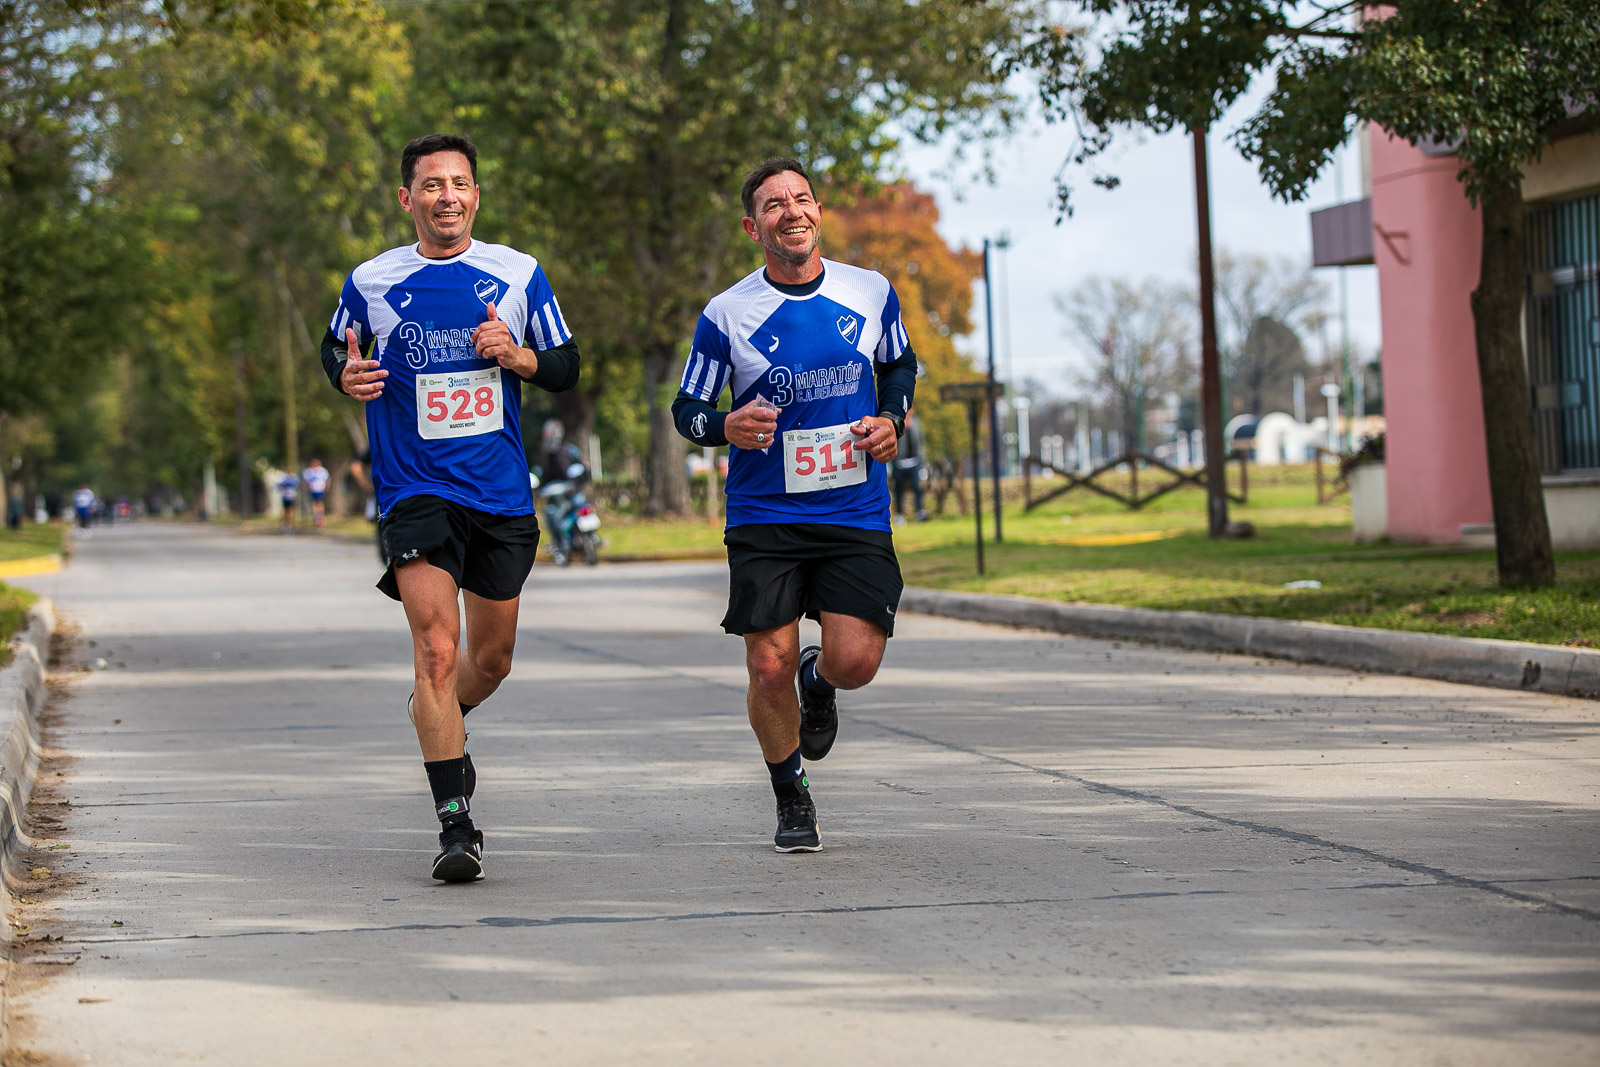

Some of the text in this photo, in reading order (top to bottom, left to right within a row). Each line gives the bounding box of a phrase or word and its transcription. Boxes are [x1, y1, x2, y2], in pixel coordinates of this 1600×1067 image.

[399, 322, 428, 369] 3
[768, 366, 794, 407] 3
[795, 360, 862, 390] MARATÓN
[426, 386, 495, 422] 528
[795, 439, 858, 476] 511
